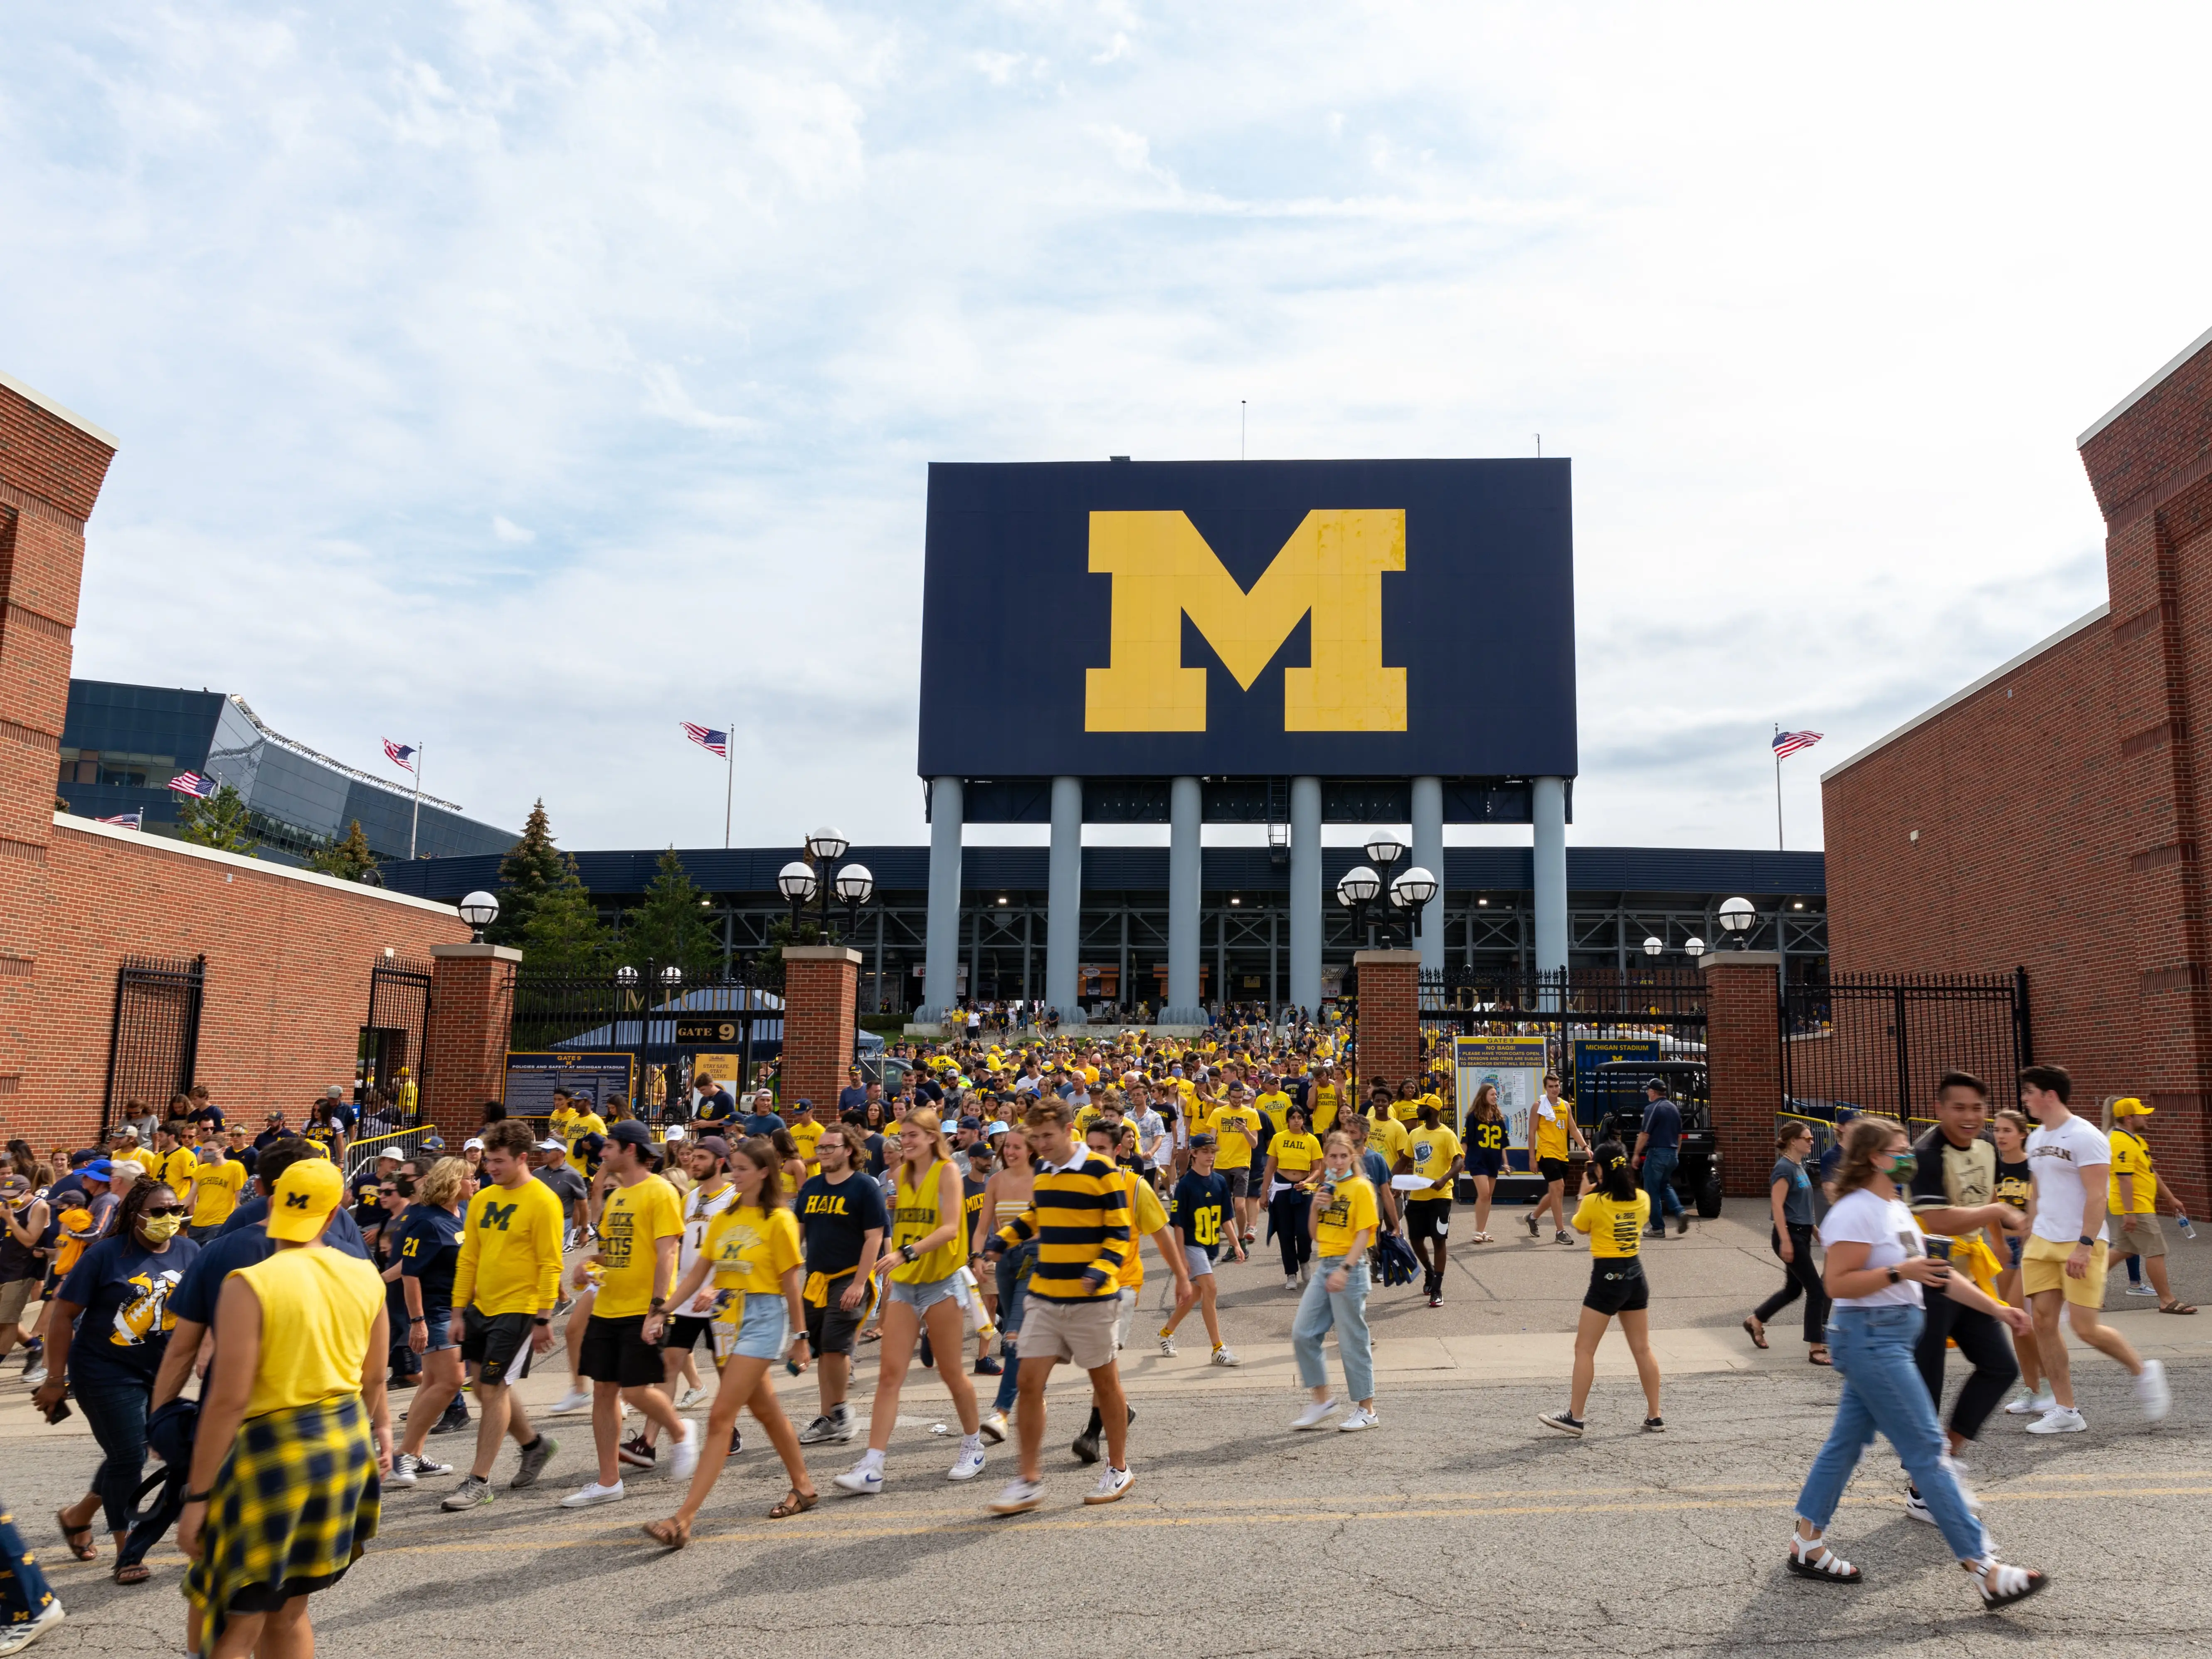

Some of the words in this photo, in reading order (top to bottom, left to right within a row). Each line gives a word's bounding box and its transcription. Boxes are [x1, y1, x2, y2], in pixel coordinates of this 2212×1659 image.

[1085, 508, 1408, 732] M
[678, 1028, 712, 1036] GATE
[719, 1024, 735, 1040] 9
[1198, 1104, 1204, 1119] 1
[1265, 1103, 1286, 1111] MICHIGAN
[1556, 1119, 1565, 1129] 41
[1282, 1140, 1305, 1149] HAIL
[1477, 1124, 1502, 1150] 32
[189, 1160, 195, 1168] 4
[2117, 1151, 2126, 1163] 4
[155, 1162, 169, 1181] 4
[285, 1191, 311, 1209] M
[363, 1194, 377, 1205] M
[804, 1196, 849, 1215] HAIL
[479, 1201, 519, 1231] M
[1194, 1205, 1221, 1246] 02
[693, 1225, 703, 1249] 1
[402, 1237, 420, 1257] 21
[721, 1244, 744, 1259] M
[40, 1591, 53, 1606] M
[13, 1611, 29, 1622] M
